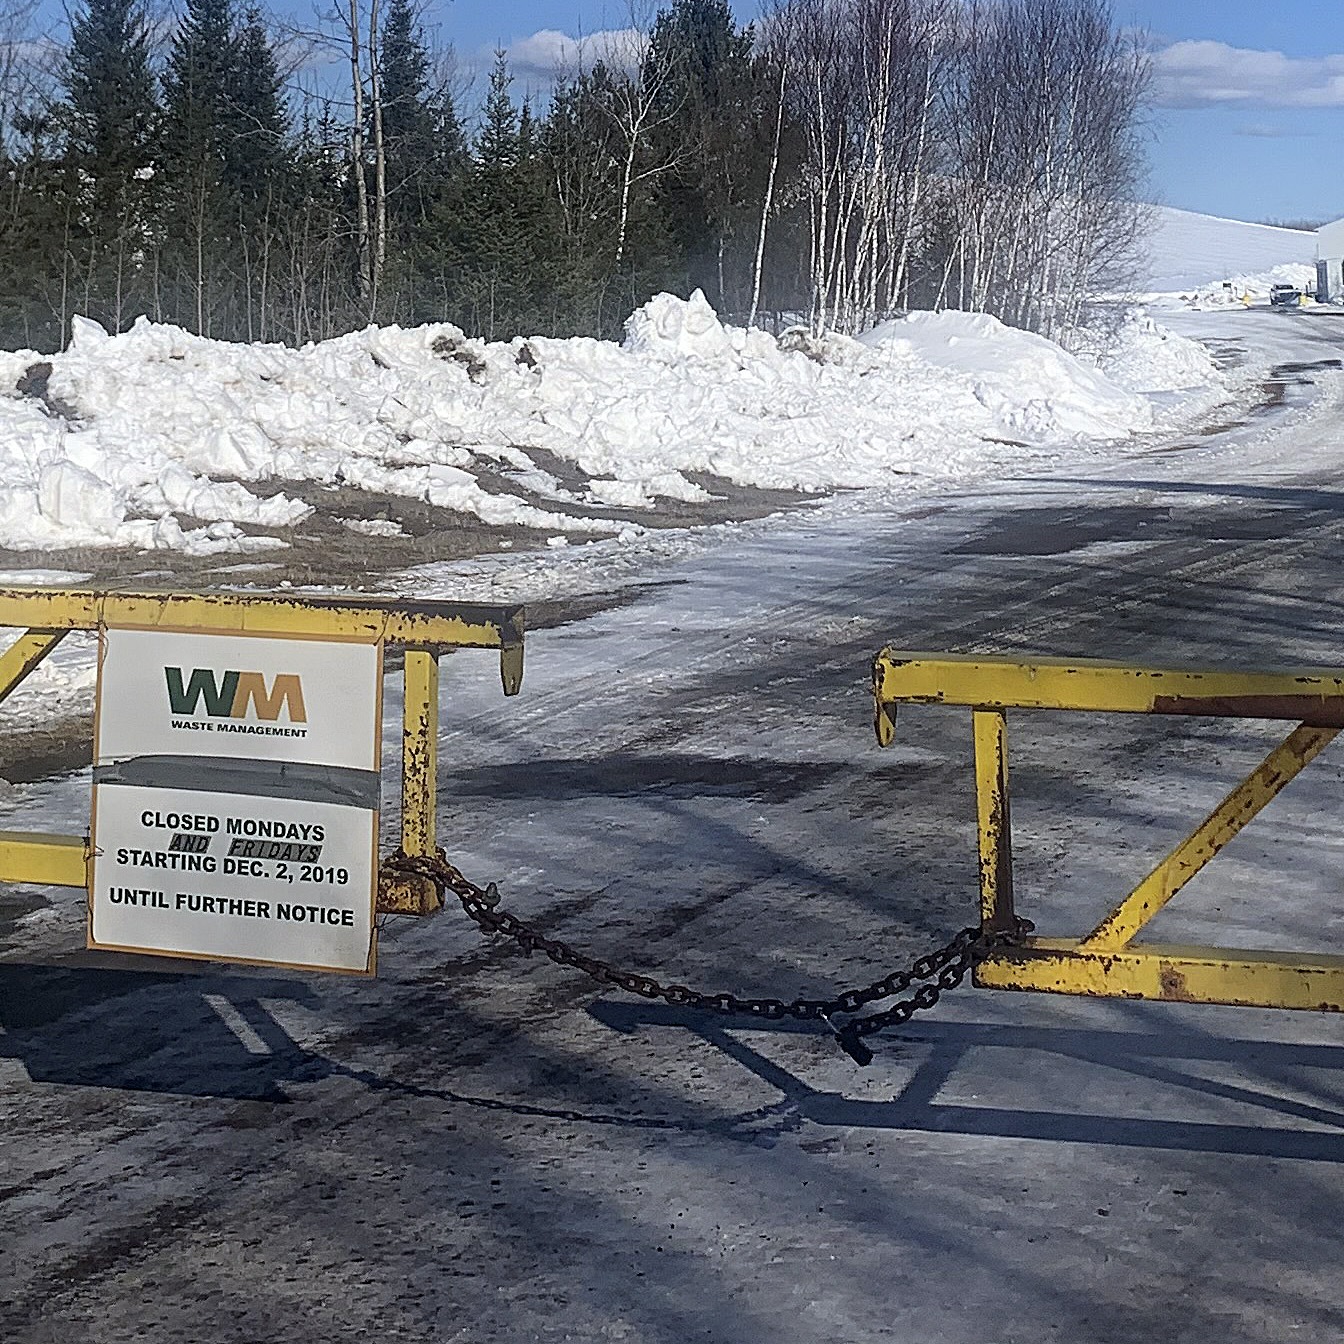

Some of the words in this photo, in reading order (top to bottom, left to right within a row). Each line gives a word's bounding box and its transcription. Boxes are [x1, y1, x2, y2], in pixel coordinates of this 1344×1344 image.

[164, 666, 307, 723] WM
[171, 720, 214, 732] WASTE
[217, 723, 308, 738] MANAGEMENT
[141, 811, 220, 833] CLOSED
[226, 817, 325, 841] MONDAYS
[169, 834, 210, 853] AND
[229, 838, 320, 863] FRIDAYS
[116, 849, 217, 873] STARTING
[223, 858, 270, 878] DEC.
[275, 863, 294, 884] 2,
[299, 865, 349, 885] 2019
[110, 887, 170, 909] UNTIL
[176, 893, 270, 919] FURTHER
[276, 903, 354, 927] NOTICE
